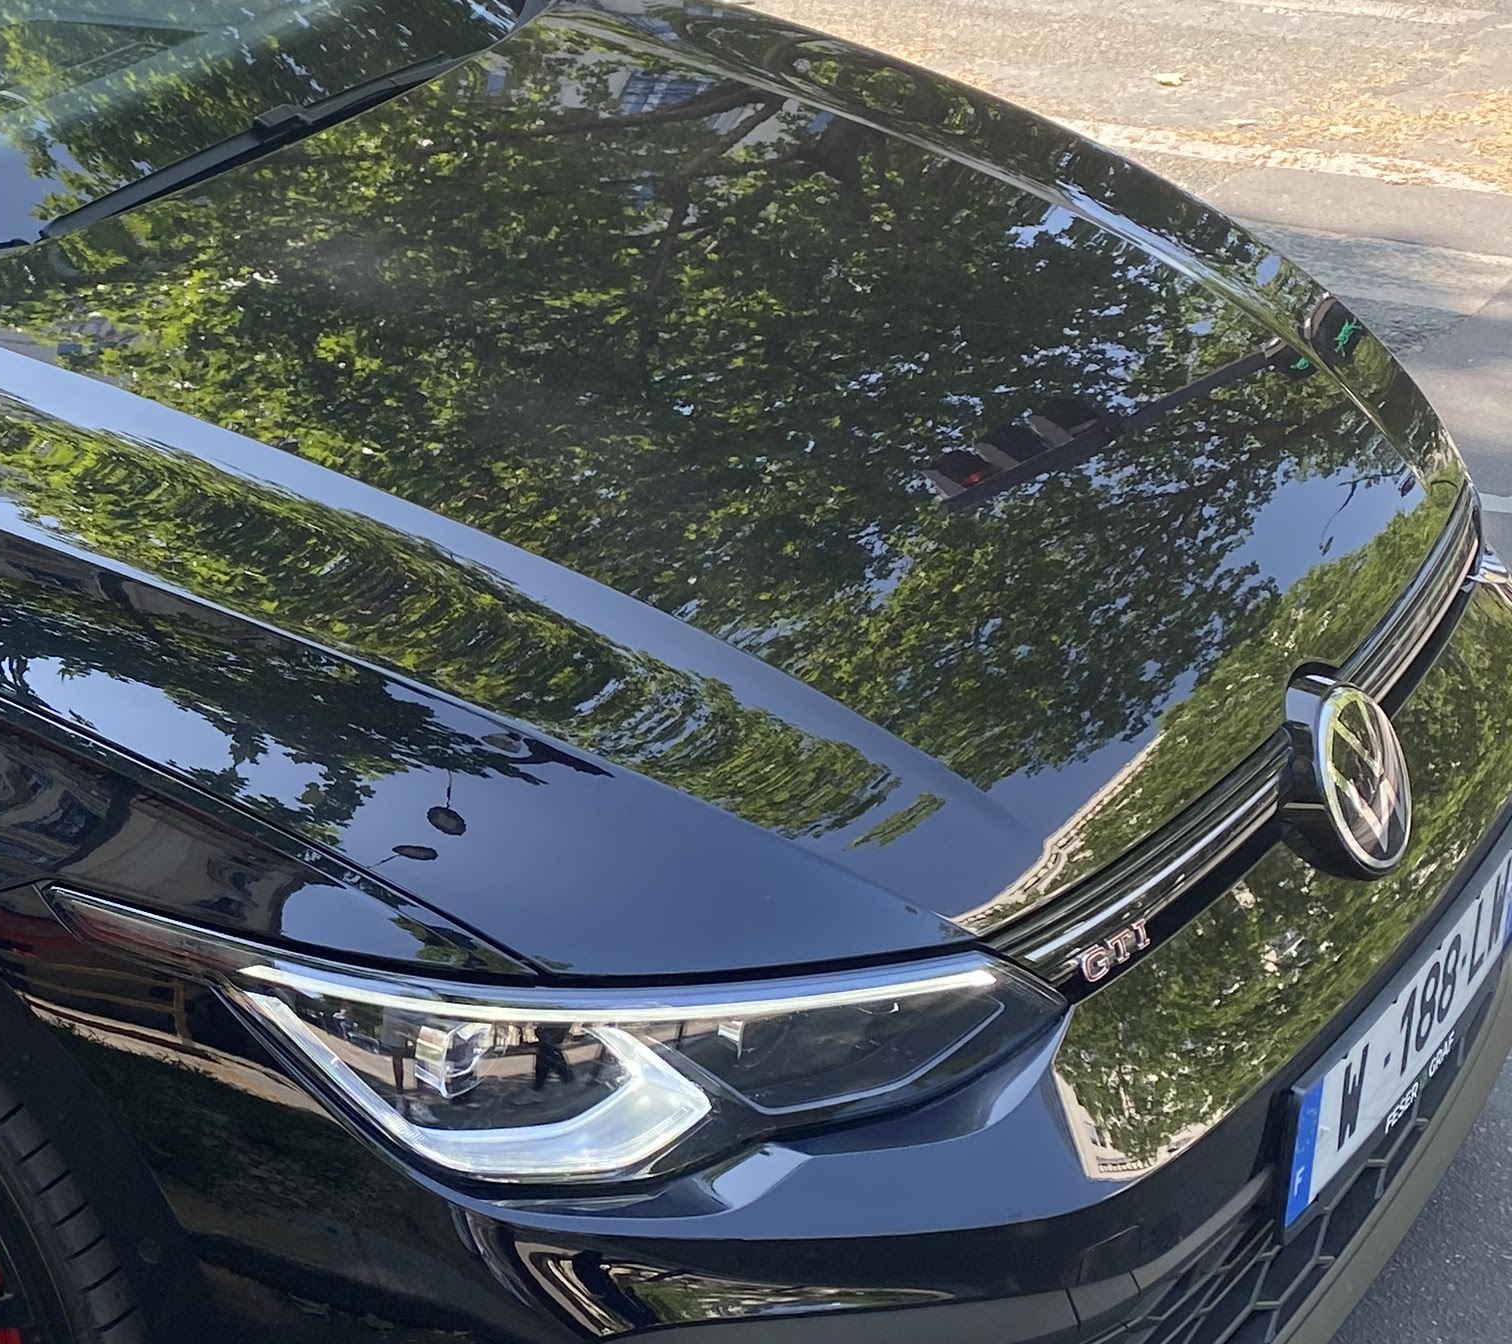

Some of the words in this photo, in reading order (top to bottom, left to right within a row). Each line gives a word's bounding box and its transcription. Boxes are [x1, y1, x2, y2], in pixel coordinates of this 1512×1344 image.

[1081, 917, 1151, 983] GTI
[1385, 1081, 1420, 1135] FESER
[1428, 1030, 1456, 1078] GRAF
[1293, 1164, 1306, 1197] F
